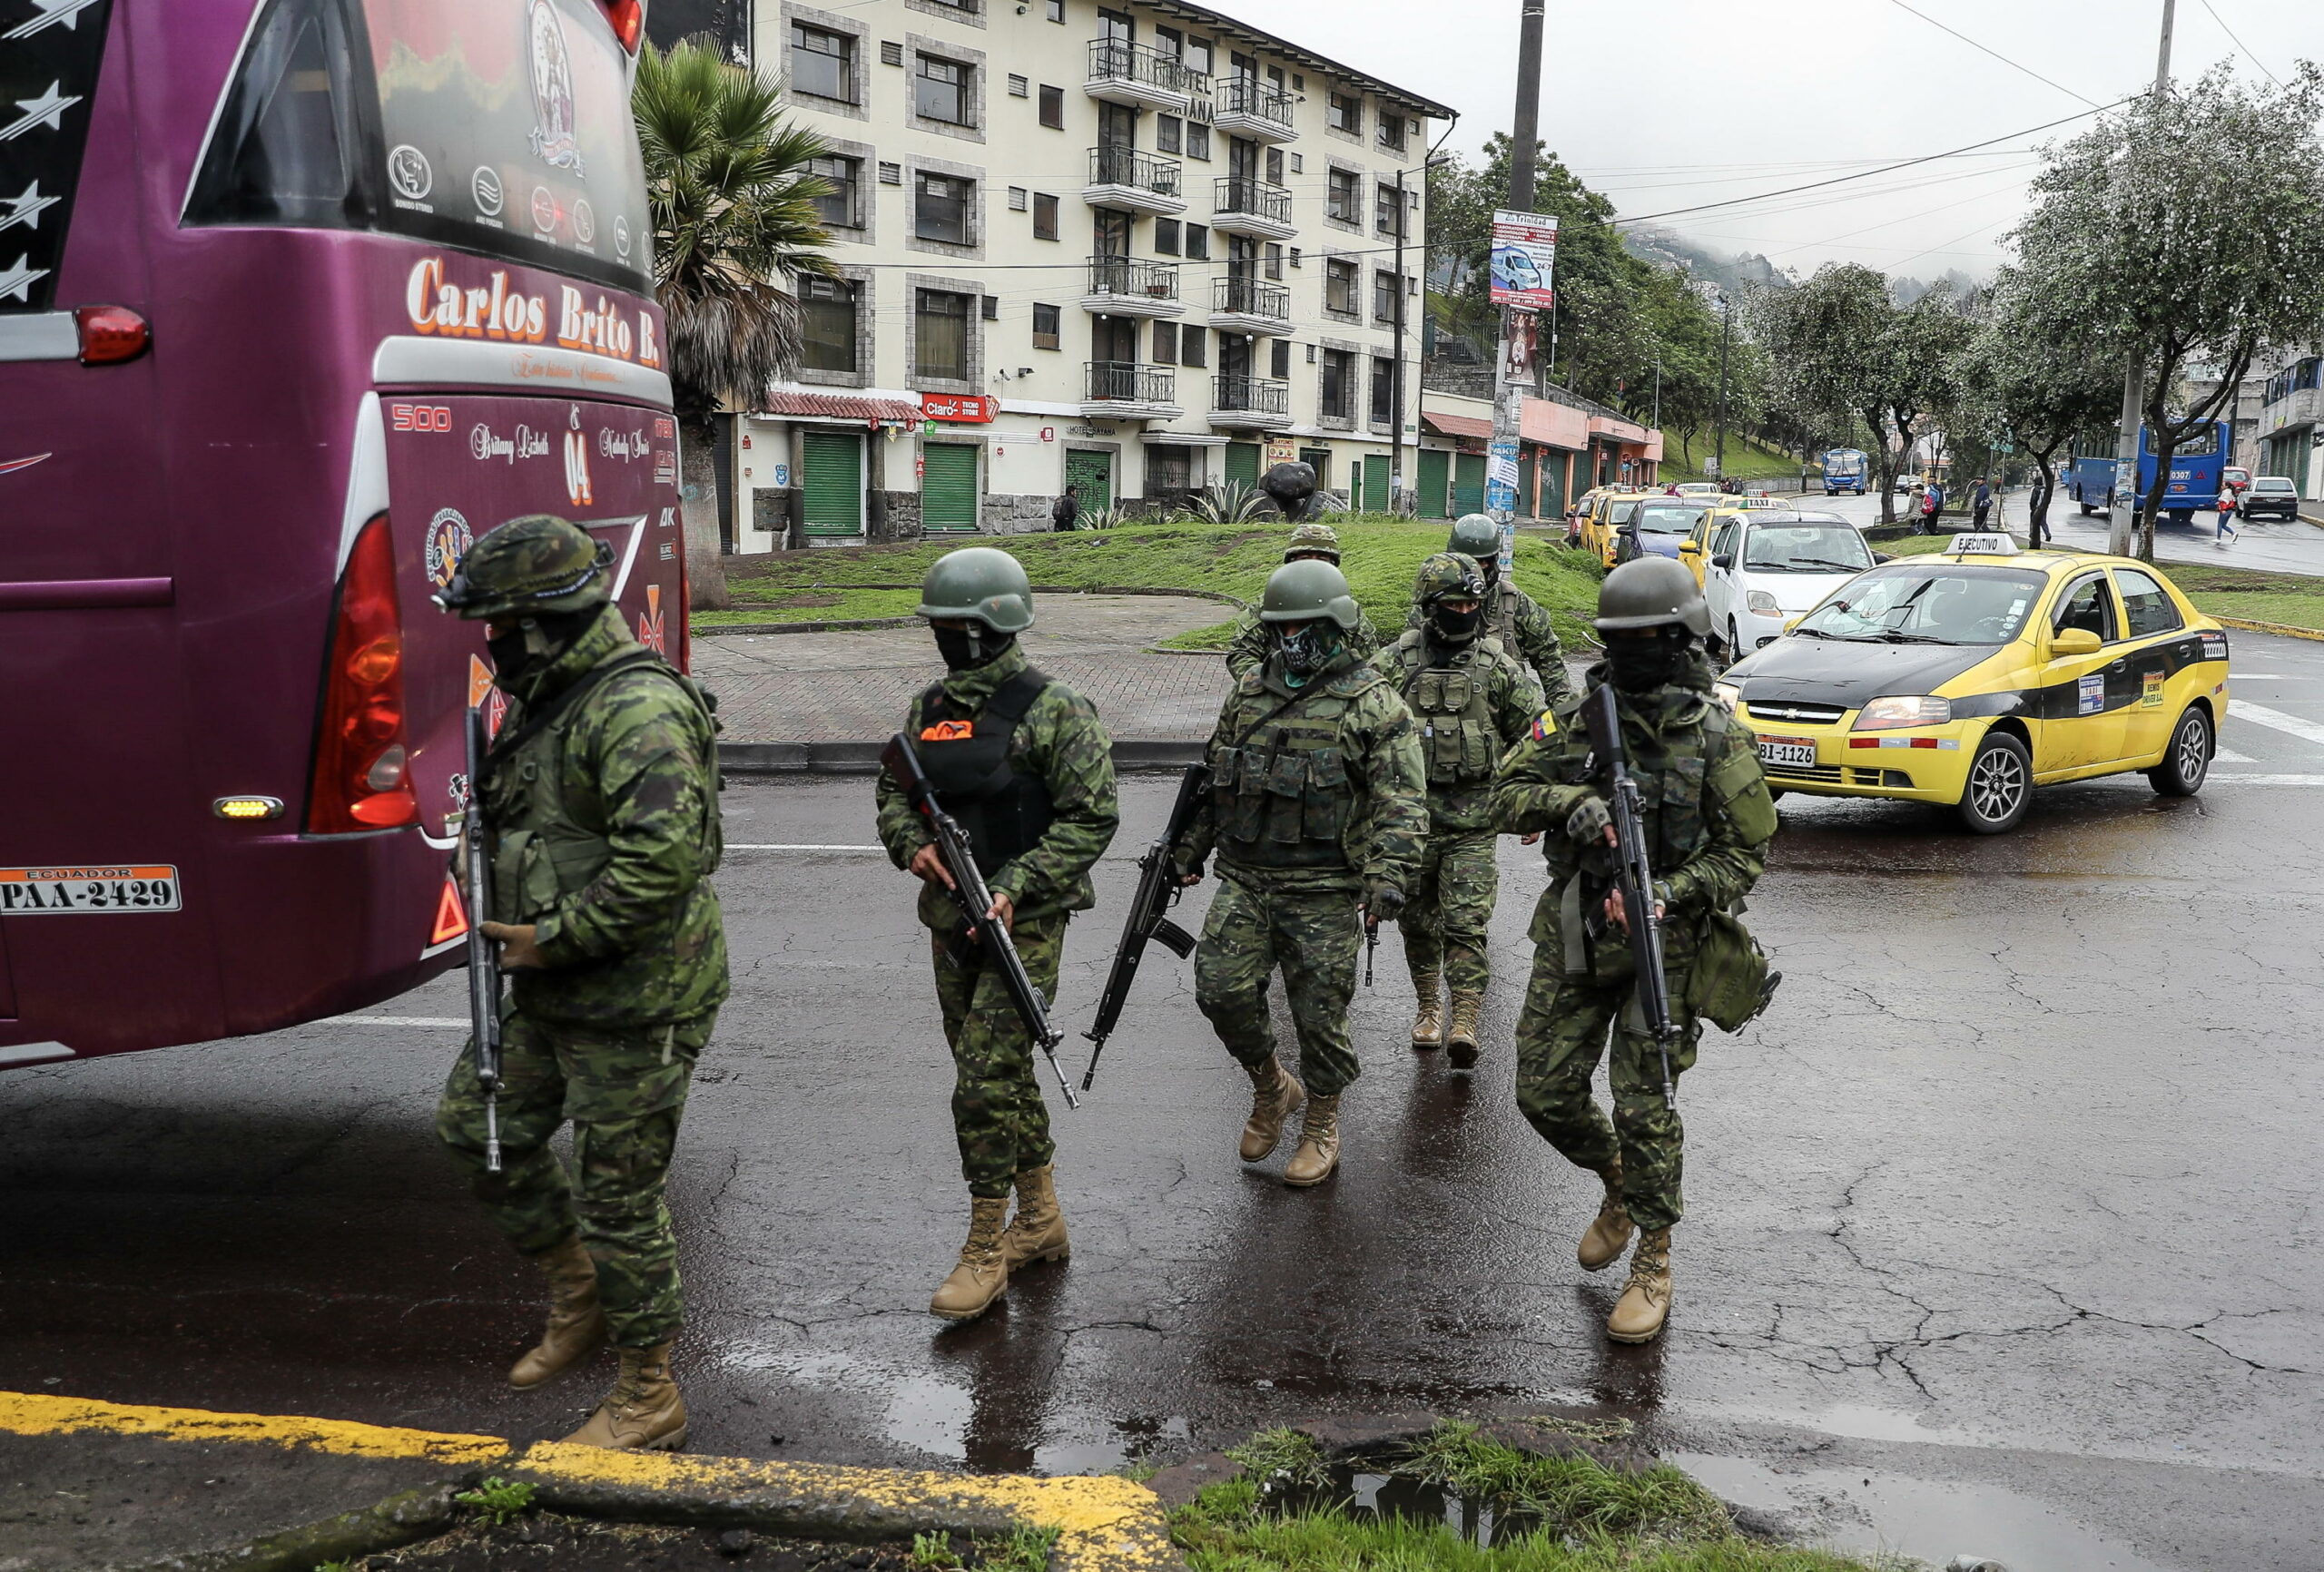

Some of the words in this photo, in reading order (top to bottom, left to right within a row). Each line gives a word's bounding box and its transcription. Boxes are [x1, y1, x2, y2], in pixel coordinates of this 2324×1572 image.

[1516, 214, 1547, 226] Trinidad
[408, 257, 546, 343] Carlos
[558, 284, 632, 359] Brito
[638, 310, 660, 368] B.
[927, 399, 958, 416] Claro
[392, 404, 452, 433] 500
[564, 430, 593, 506] 04
[2171, 471, 2190, 479] 0307
[659, 507, 675, 526] AK
[1958, 538, 1998, 551] EJECUTIVO
[2085, 686, 2098, 696] TAXI
[1759, 743, 1813, 763] BI-1126
[26, 869, 132, 879] ECUADOR
[0, 879, 172, 909] PAA-2429
